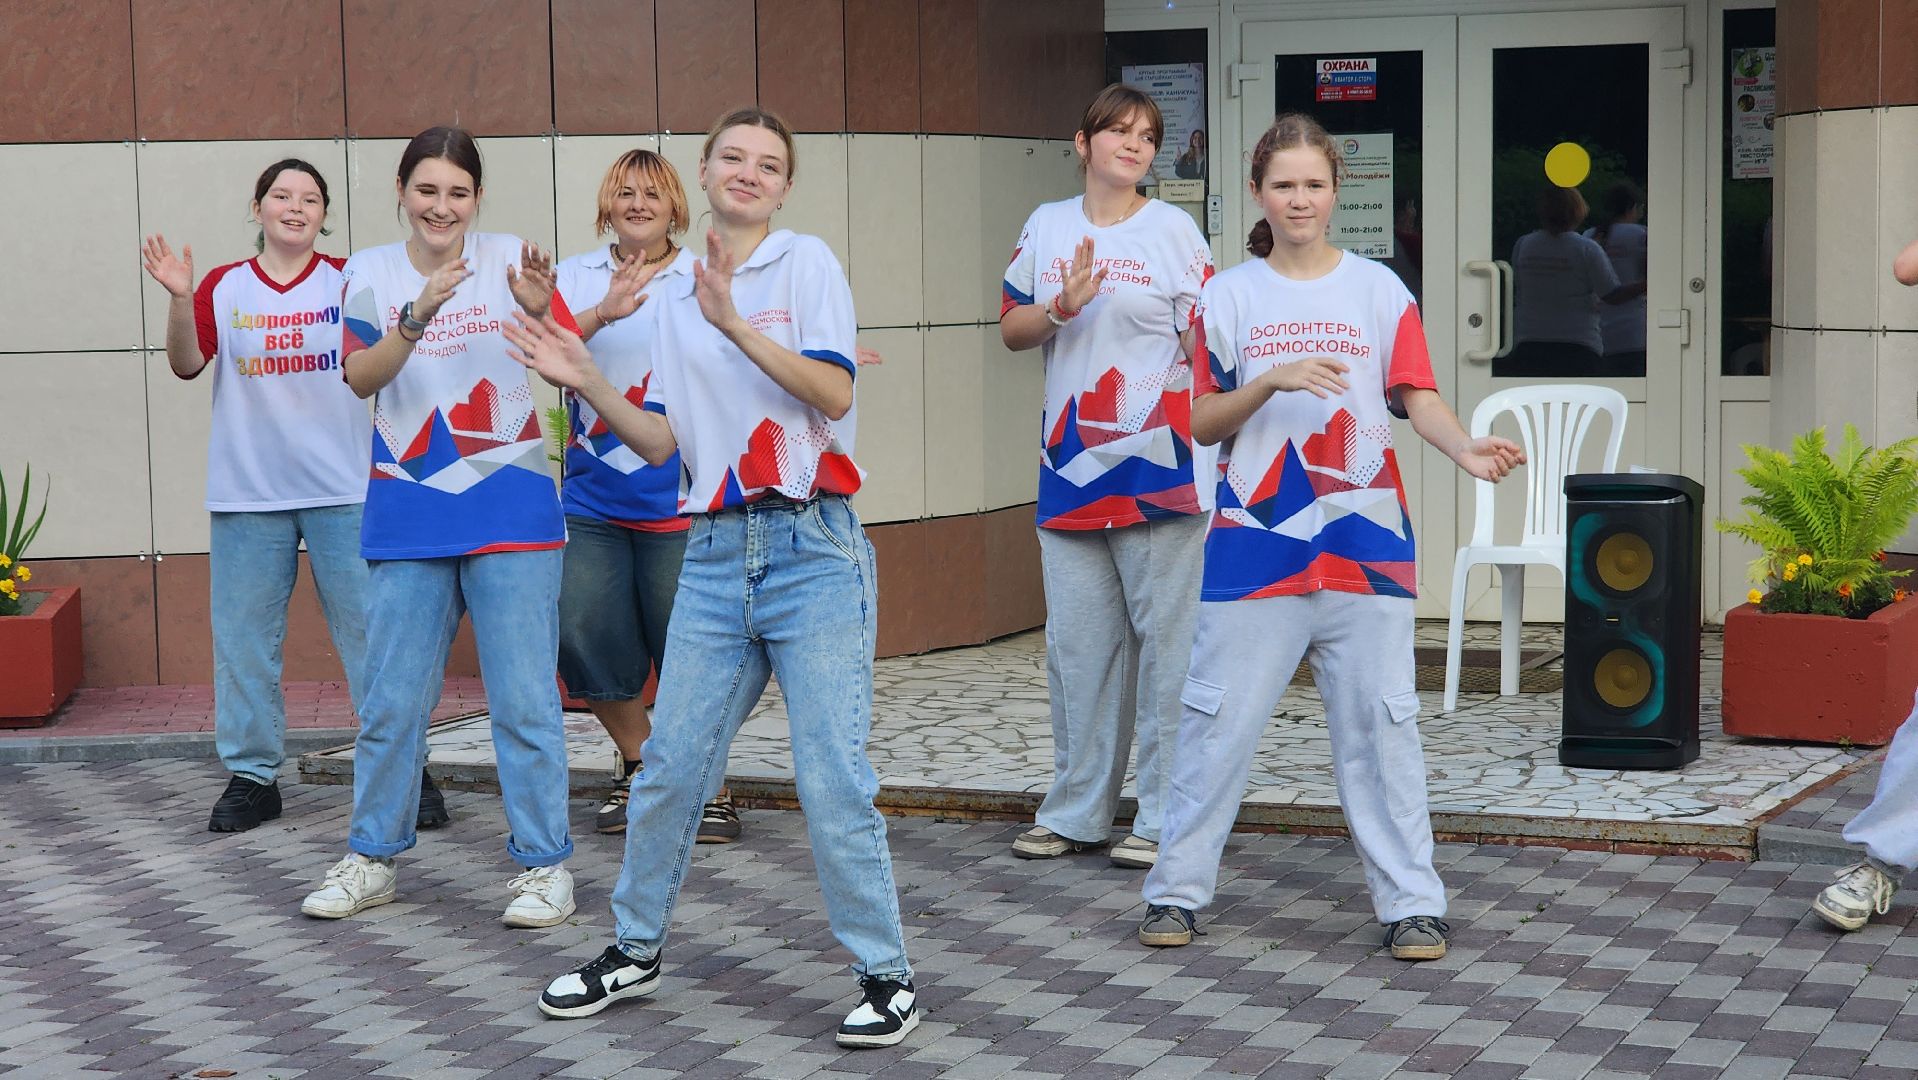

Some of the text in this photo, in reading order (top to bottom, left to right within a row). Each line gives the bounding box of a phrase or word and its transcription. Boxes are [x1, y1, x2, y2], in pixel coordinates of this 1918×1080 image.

[1323, 60, 1370, 71] ОХРАНА
[1346, 172, 1390, 180] Молодёжи
[1052, 257, 1145, 271] ВОНТЕРЫ
[1040, 271, 1151, 287] ПОДКОВЬЯ
[389, 304, 487, 326] ВНТЕРЫ
[264, 328, 304, 350] всё
[386, 320, 500, 342] ОСКОВЬЯ
[1250, 322, 1361, 340] ВОЛОНТЕРЫ
[428, 343, 468, 358] РЯДОМ
[1243, 339, 1370, 362] ПОДМОСКОВЬЯ
[236, 349, 338, 378] здорово!
